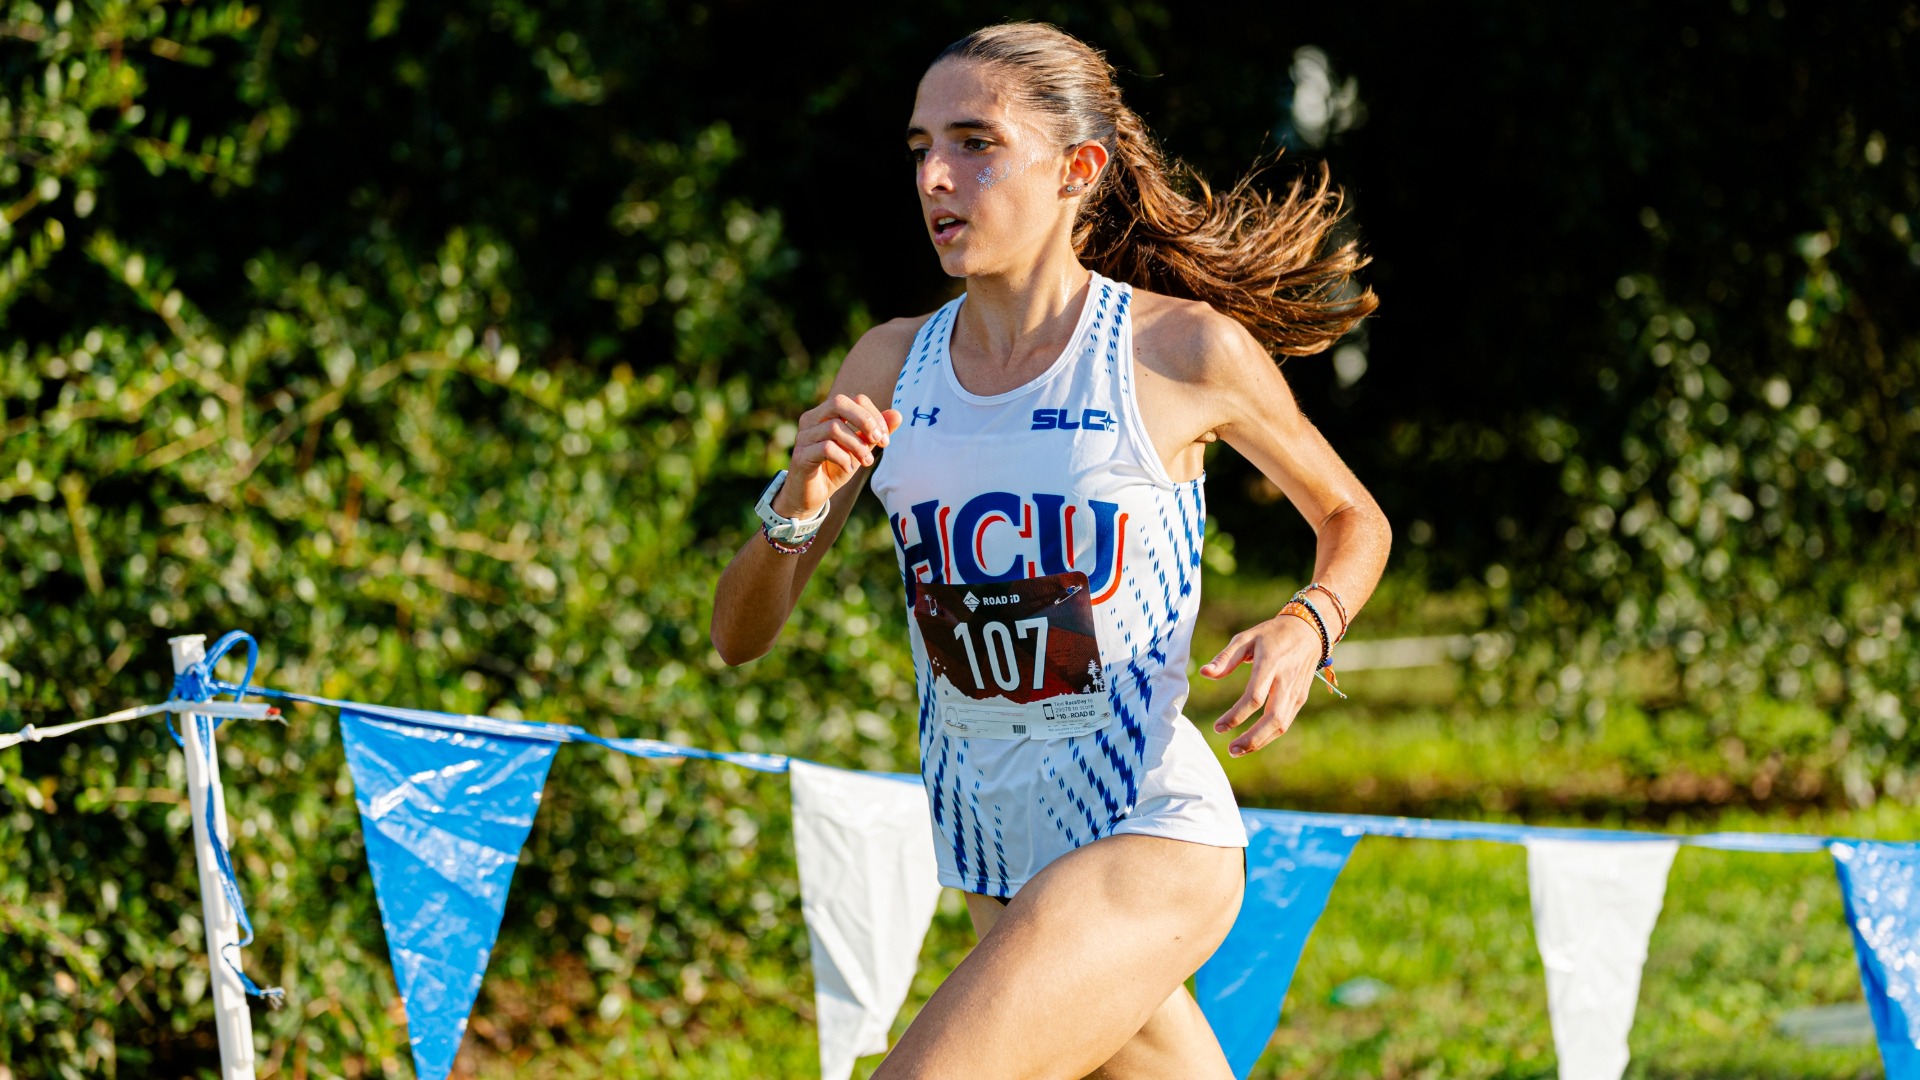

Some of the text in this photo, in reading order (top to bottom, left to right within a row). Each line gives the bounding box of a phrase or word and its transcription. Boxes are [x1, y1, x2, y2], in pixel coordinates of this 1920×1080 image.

[1031, 408, 1108, 431] SLC
[890, 491, 1128, 608] HCU
[982, 595, 1008, 606] ROAD
[953, 616, 1049, 692] 107
